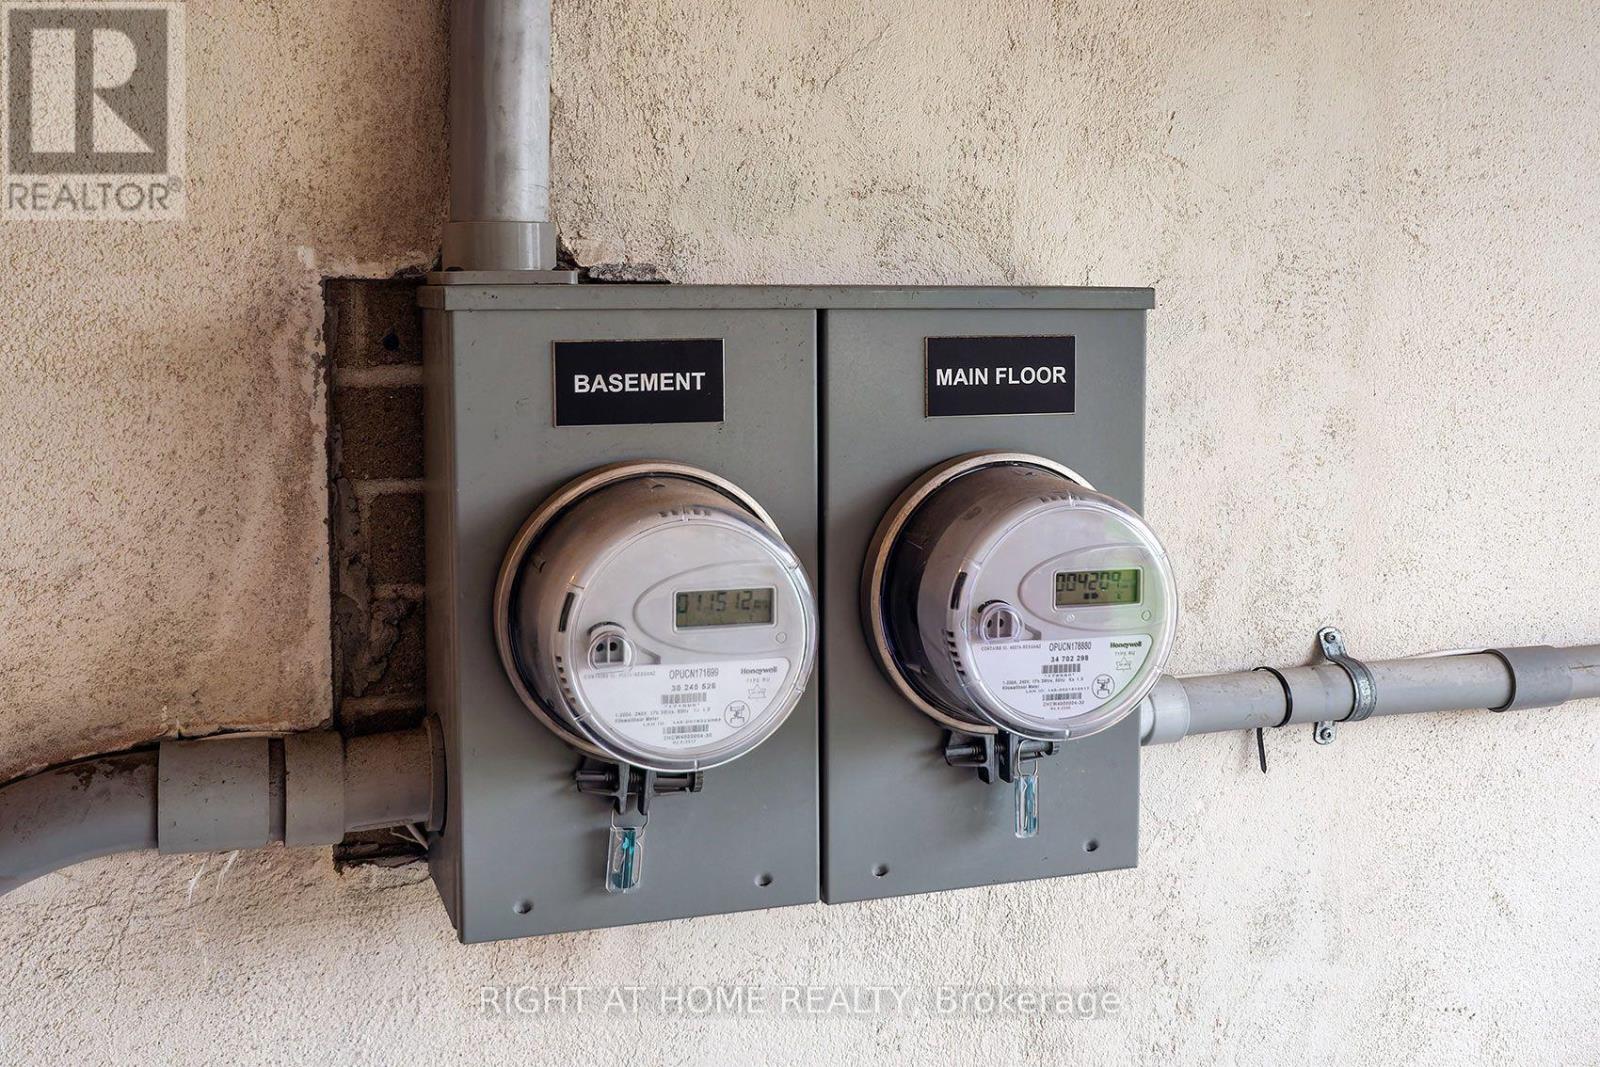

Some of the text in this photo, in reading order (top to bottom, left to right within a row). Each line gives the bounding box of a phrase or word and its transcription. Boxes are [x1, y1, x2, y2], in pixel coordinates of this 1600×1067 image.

[573, 372, 706, 393] BASEMENT
[936, 366, 1067, 386] MAIN FLOOR
[1110, 641, 1142, 649] Honeywell
[740, 666, 778, 675] Honeywell
